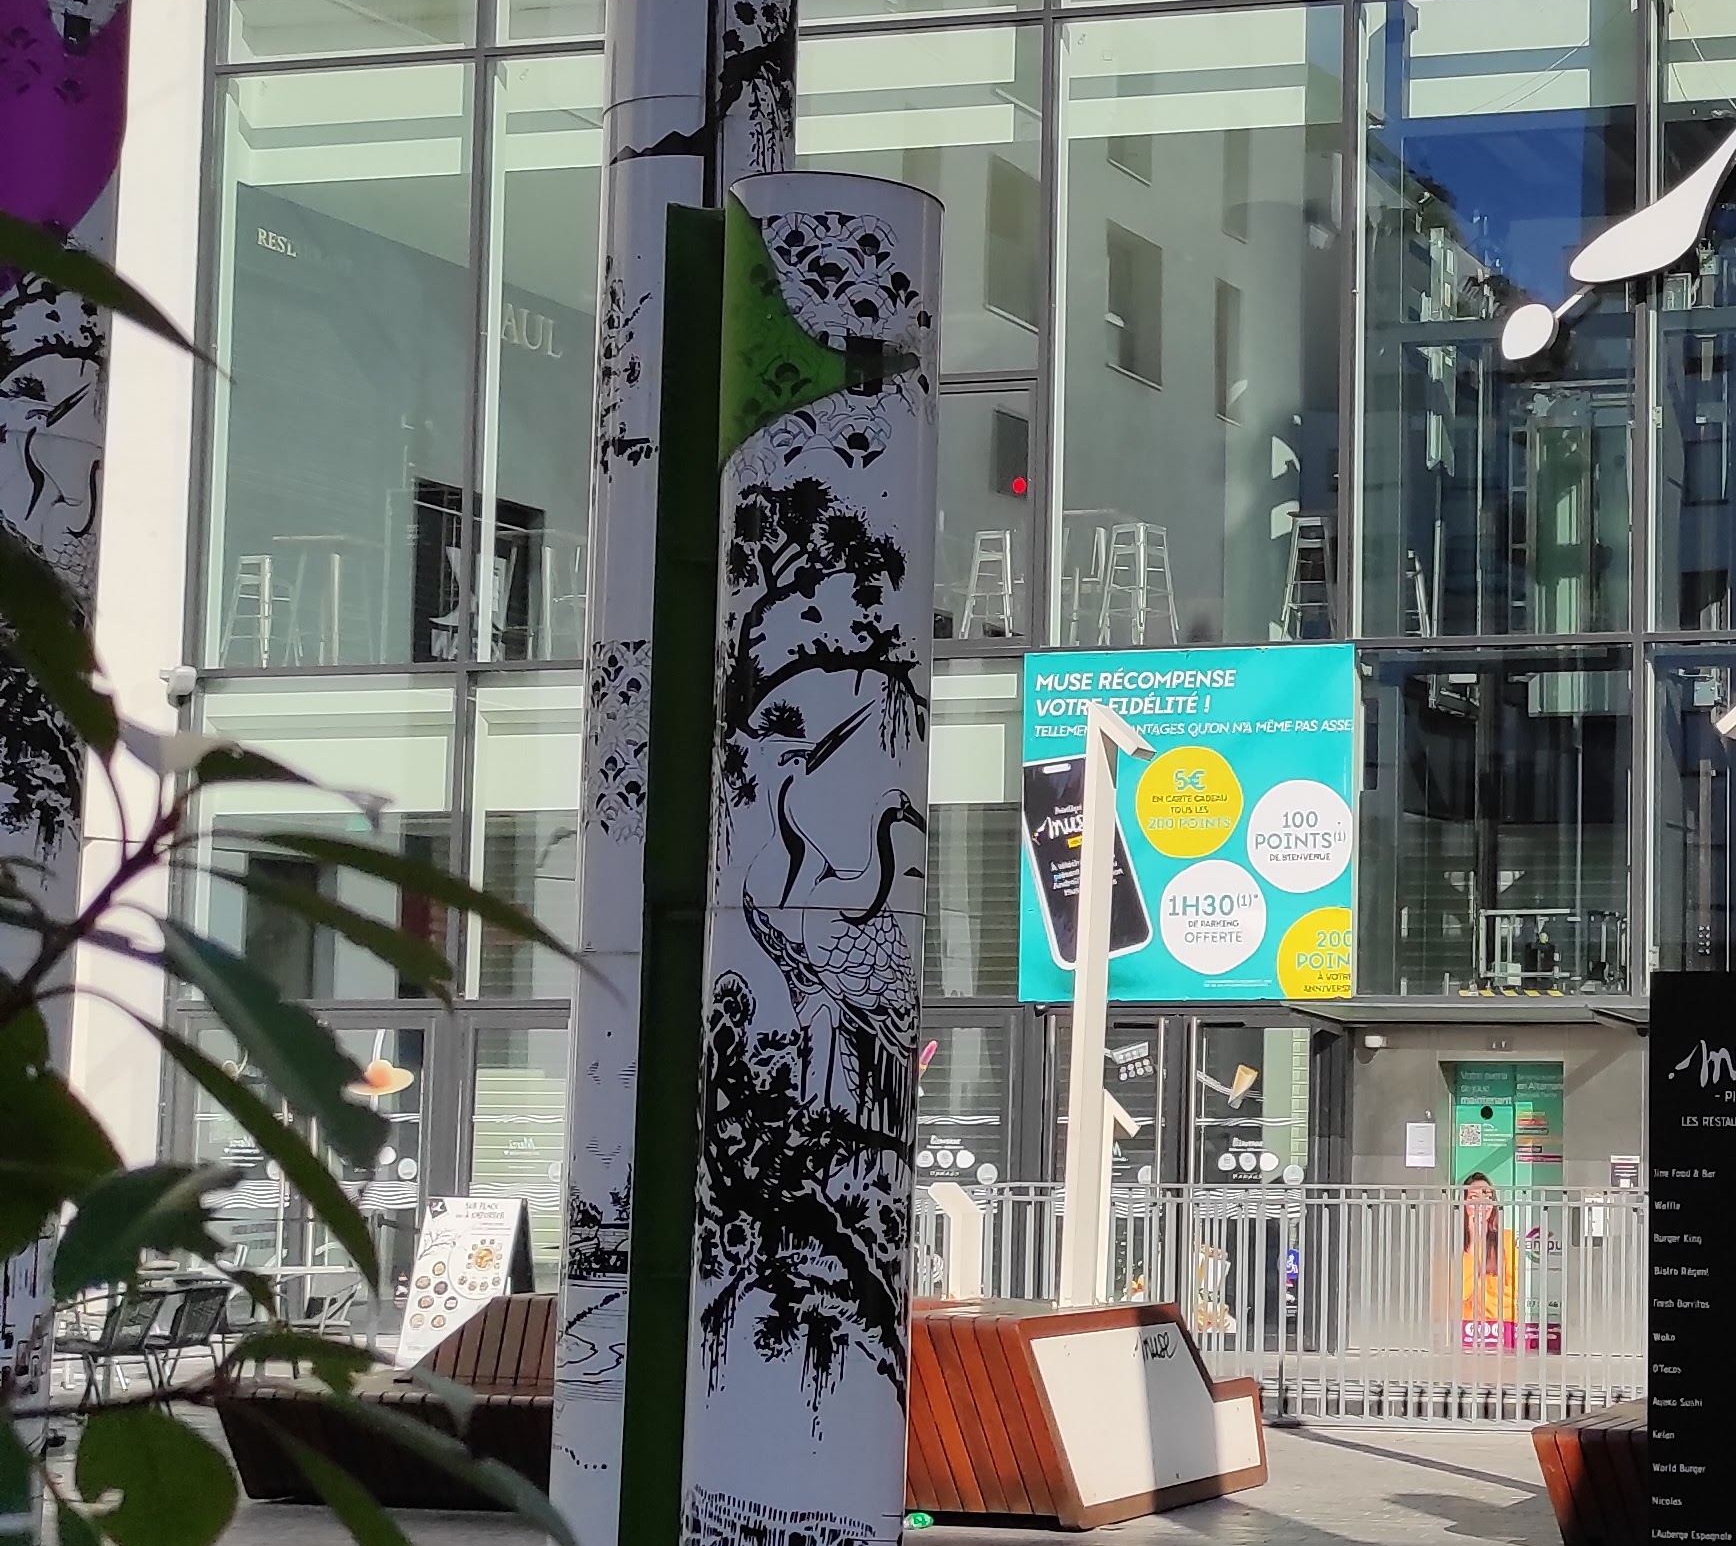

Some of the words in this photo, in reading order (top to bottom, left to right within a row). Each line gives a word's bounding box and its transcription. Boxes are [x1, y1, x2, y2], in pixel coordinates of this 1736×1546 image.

[1035, 672, 1093, 691] MUSE
[1098, 667, 1237, 690] RÉCOMPENSE
[1108, 691, 1199, 715] FIDÉLITÉ
[1256, 719, 1293, 733] MÊME
[1295, 719, 1319, 732] PAS
[1320, 719, 1354, 732] ASSE
[1174, 769, 1206, 791] 5€
[1179, 818, 1231, 829] POINTS
[1282, 811, 1318, 829] 100
[1184, 931, 1243, 943] OFFERTE
[1681, 1116, 1698, 1127] LES
[1653, 1233, 1681, 1244] Burger
[1683, 1234, 1703, 1245] King
[1654, 1266, 1679, 1276] Bistro
[1652, 1463, 1677, 1473] World
[1679, 1463, 1706, 1475] Burger
[1652, 1496, 1683, 1506] Nicolas
[1691, 1530, 1733, 1542] Espagnole
